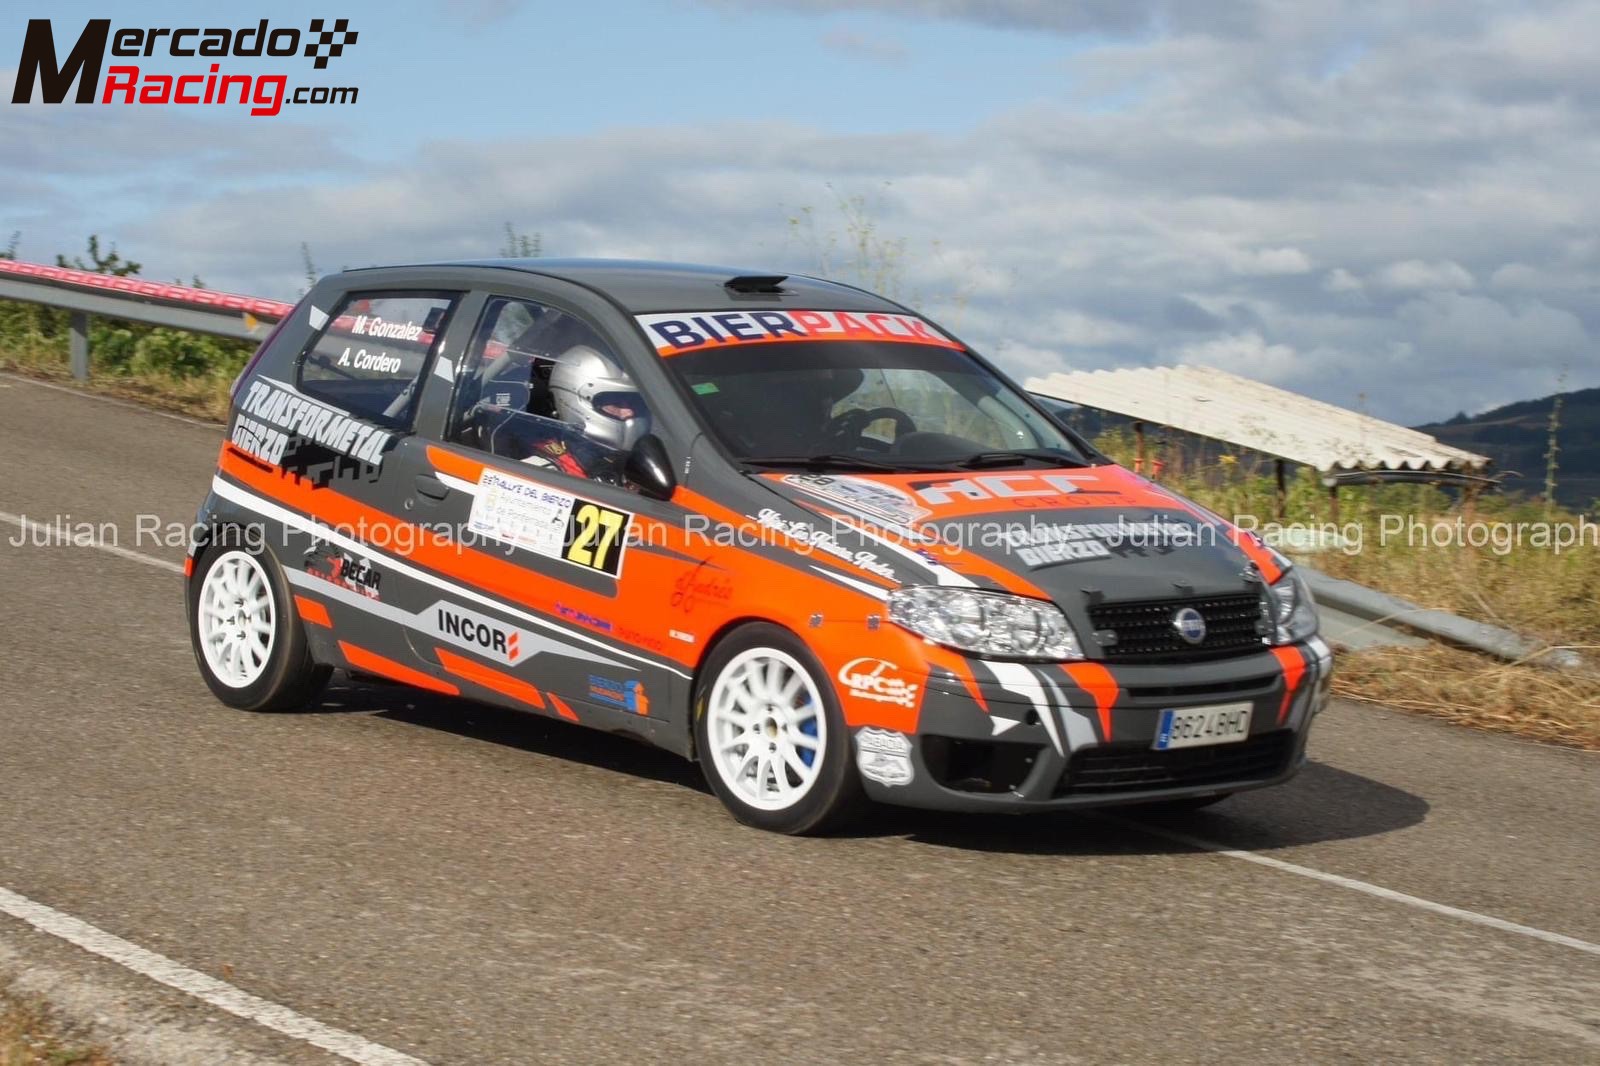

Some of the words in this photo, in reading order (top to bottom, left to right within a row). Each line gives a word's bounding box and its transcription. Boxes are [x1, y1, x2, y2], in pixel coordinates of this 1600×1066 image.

[351, 315, 367, 335] M.
[368, 316, 423, 341] Gonzalez
[649, 310, 936, 350] BIERPACK
[337, 347, 351, 367] A.
[353, 349, 402, 374] Cordero
[231, 414, 290, 466] BIERZO
[239, 381, 392, 466] TRANSFORMETAL
[567, 504, 624, 570] 27
[1014, 539, 1112, 567] BIERZO
[341, 558, 382, 590] BECAR
[437, 607, 508, 656] INCOR
